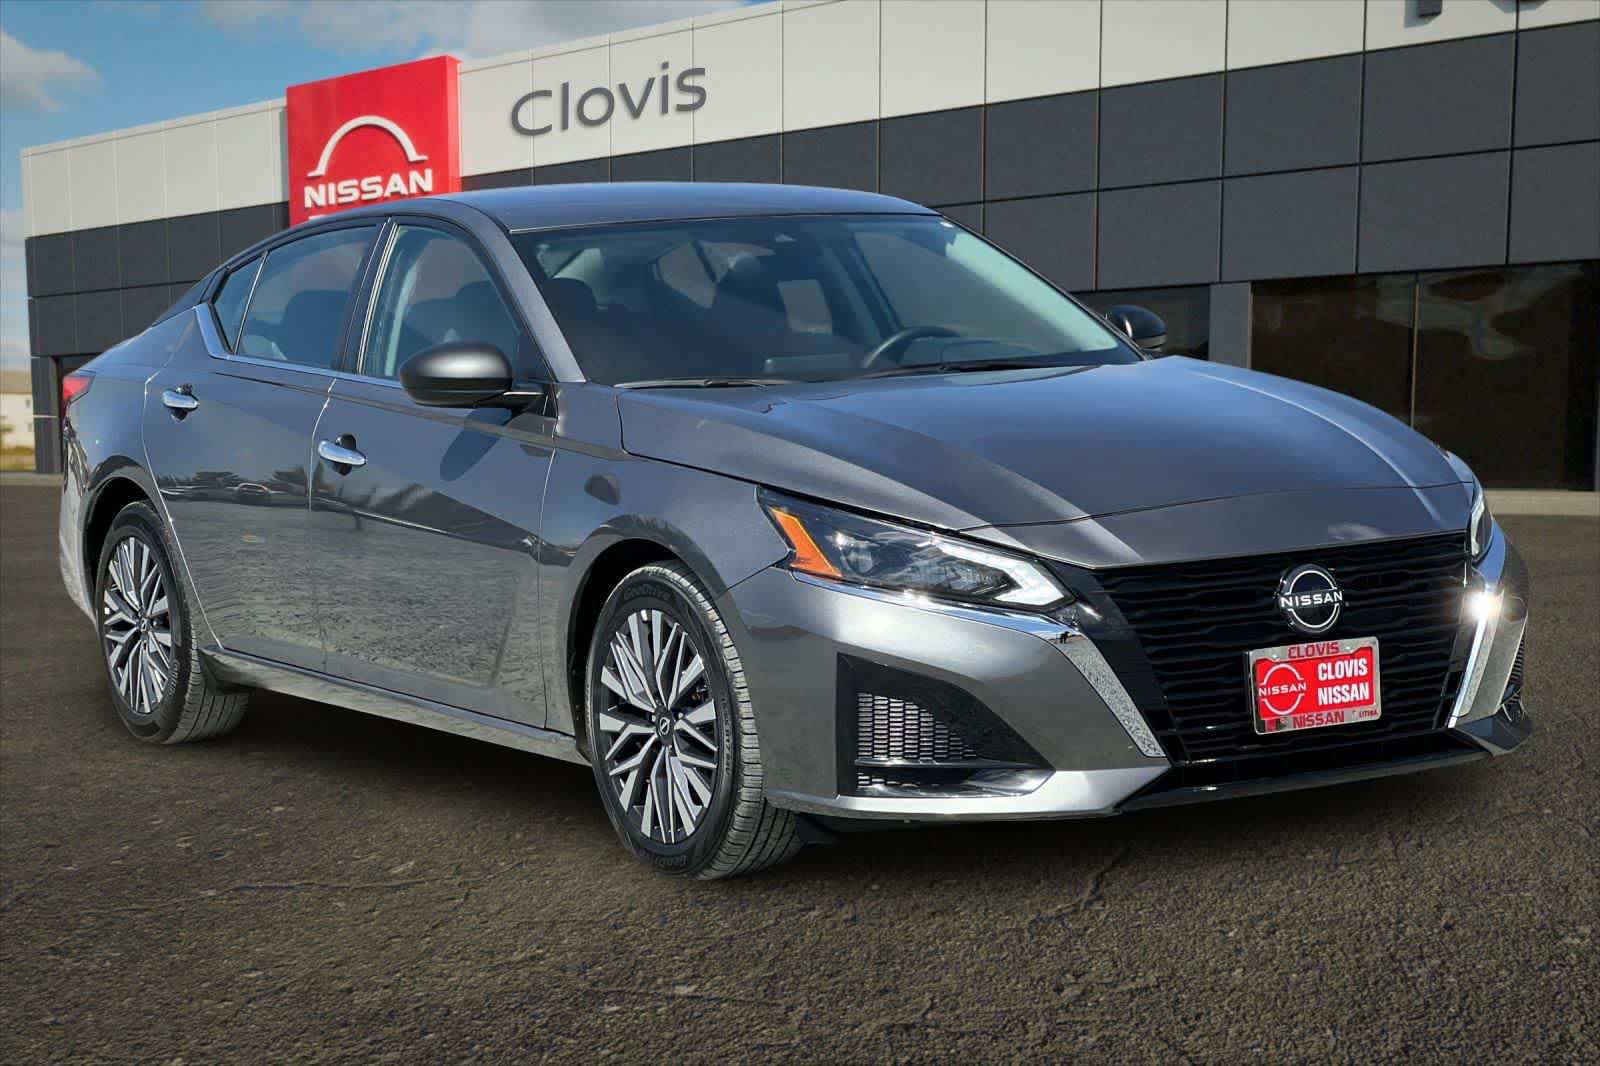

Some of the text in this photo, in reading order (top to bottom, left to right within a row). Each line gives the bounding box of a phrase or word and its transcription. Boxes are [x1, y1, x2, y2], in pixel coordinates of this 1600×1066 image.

[303, 168, 433, 209] NISSAN
[1281, 591, 1343, 608] NISSAN
[1288, 641, 1339, 659] CLOVIS
[1318, 658, 1368, 681] CLOVIS
[1258, 682, 1306, 697] NISSAN
[1318, 682, 1369, 706] NISSAN
[1293, 711, 1345, 729] NISSAN
